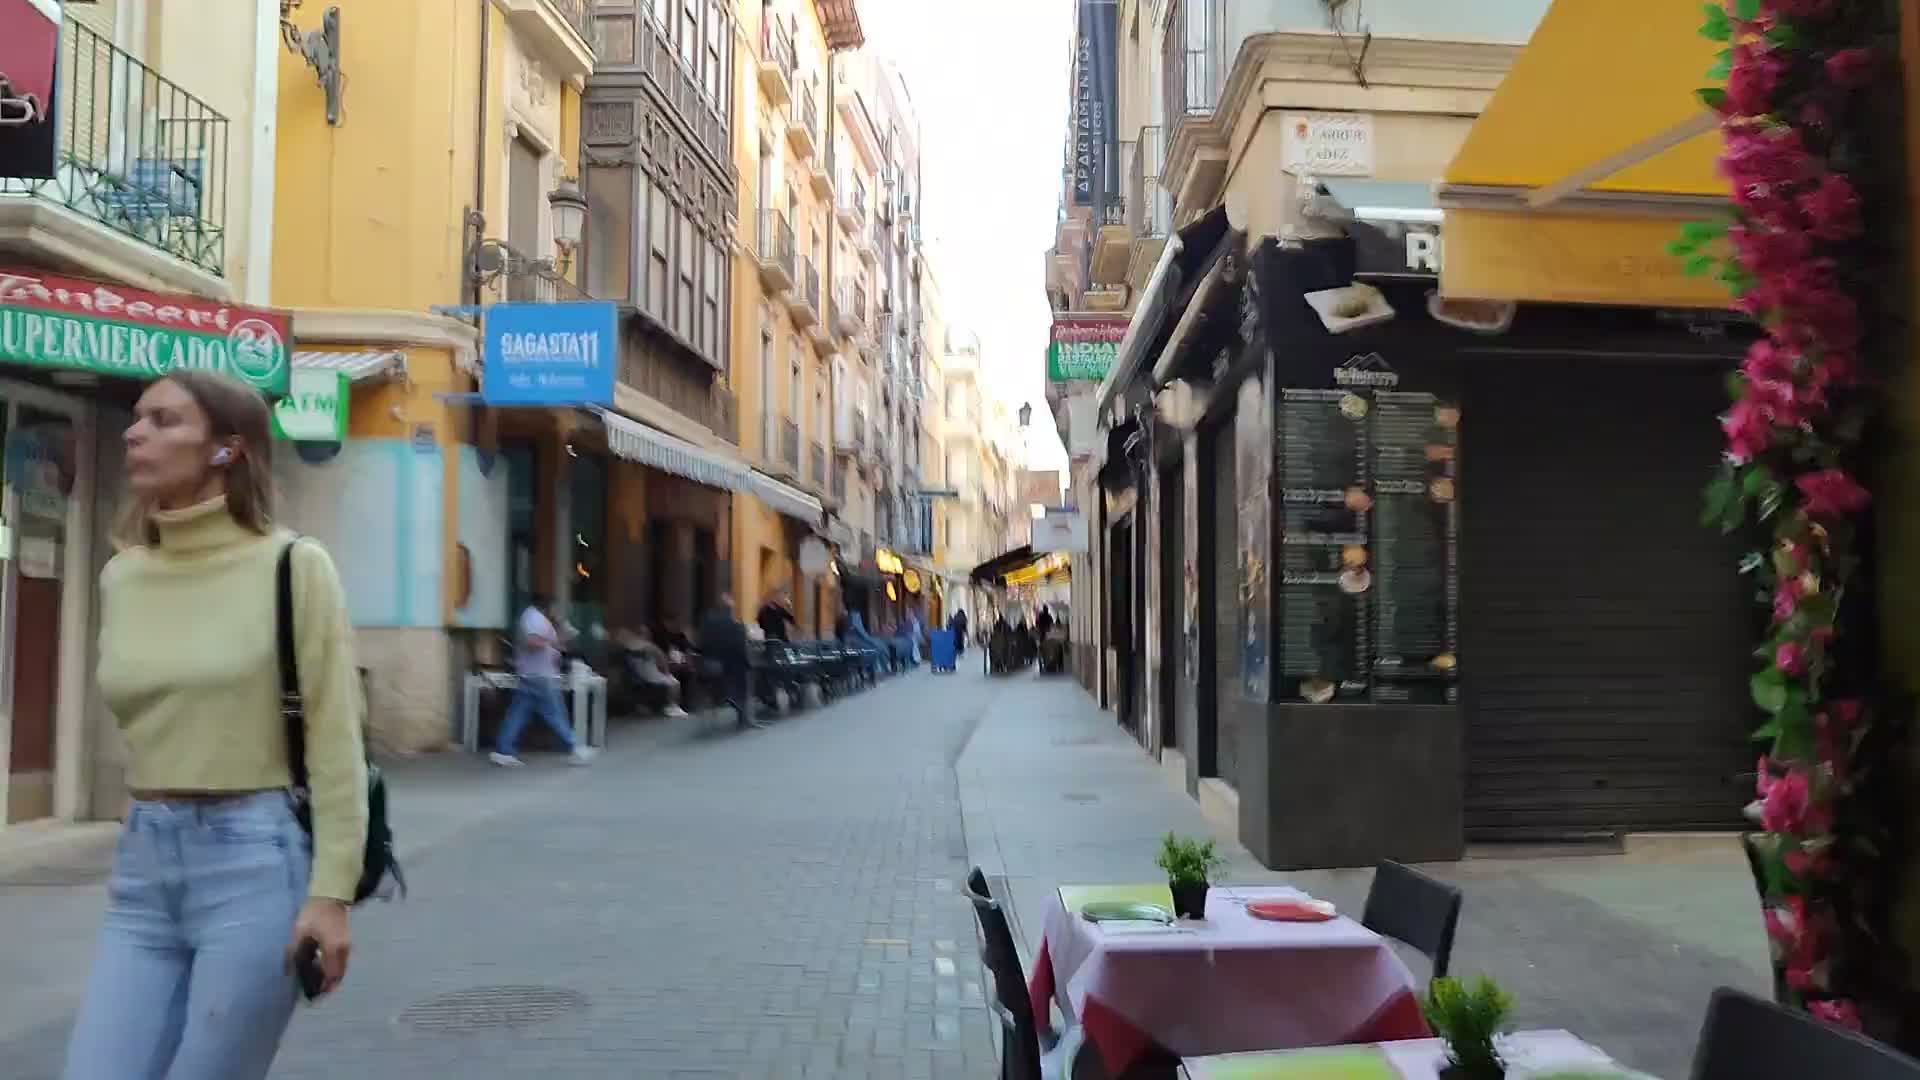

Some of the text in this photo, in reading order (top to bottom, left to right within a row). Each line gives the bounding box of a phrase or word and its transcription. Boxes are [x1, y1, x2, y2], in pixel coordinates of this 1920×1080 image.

[1077, 38, 1090, 192] APARTAMENTOS
[0, 309, 226, 377] UPERMERCADO
[280, 393, 335, 410] ATM
